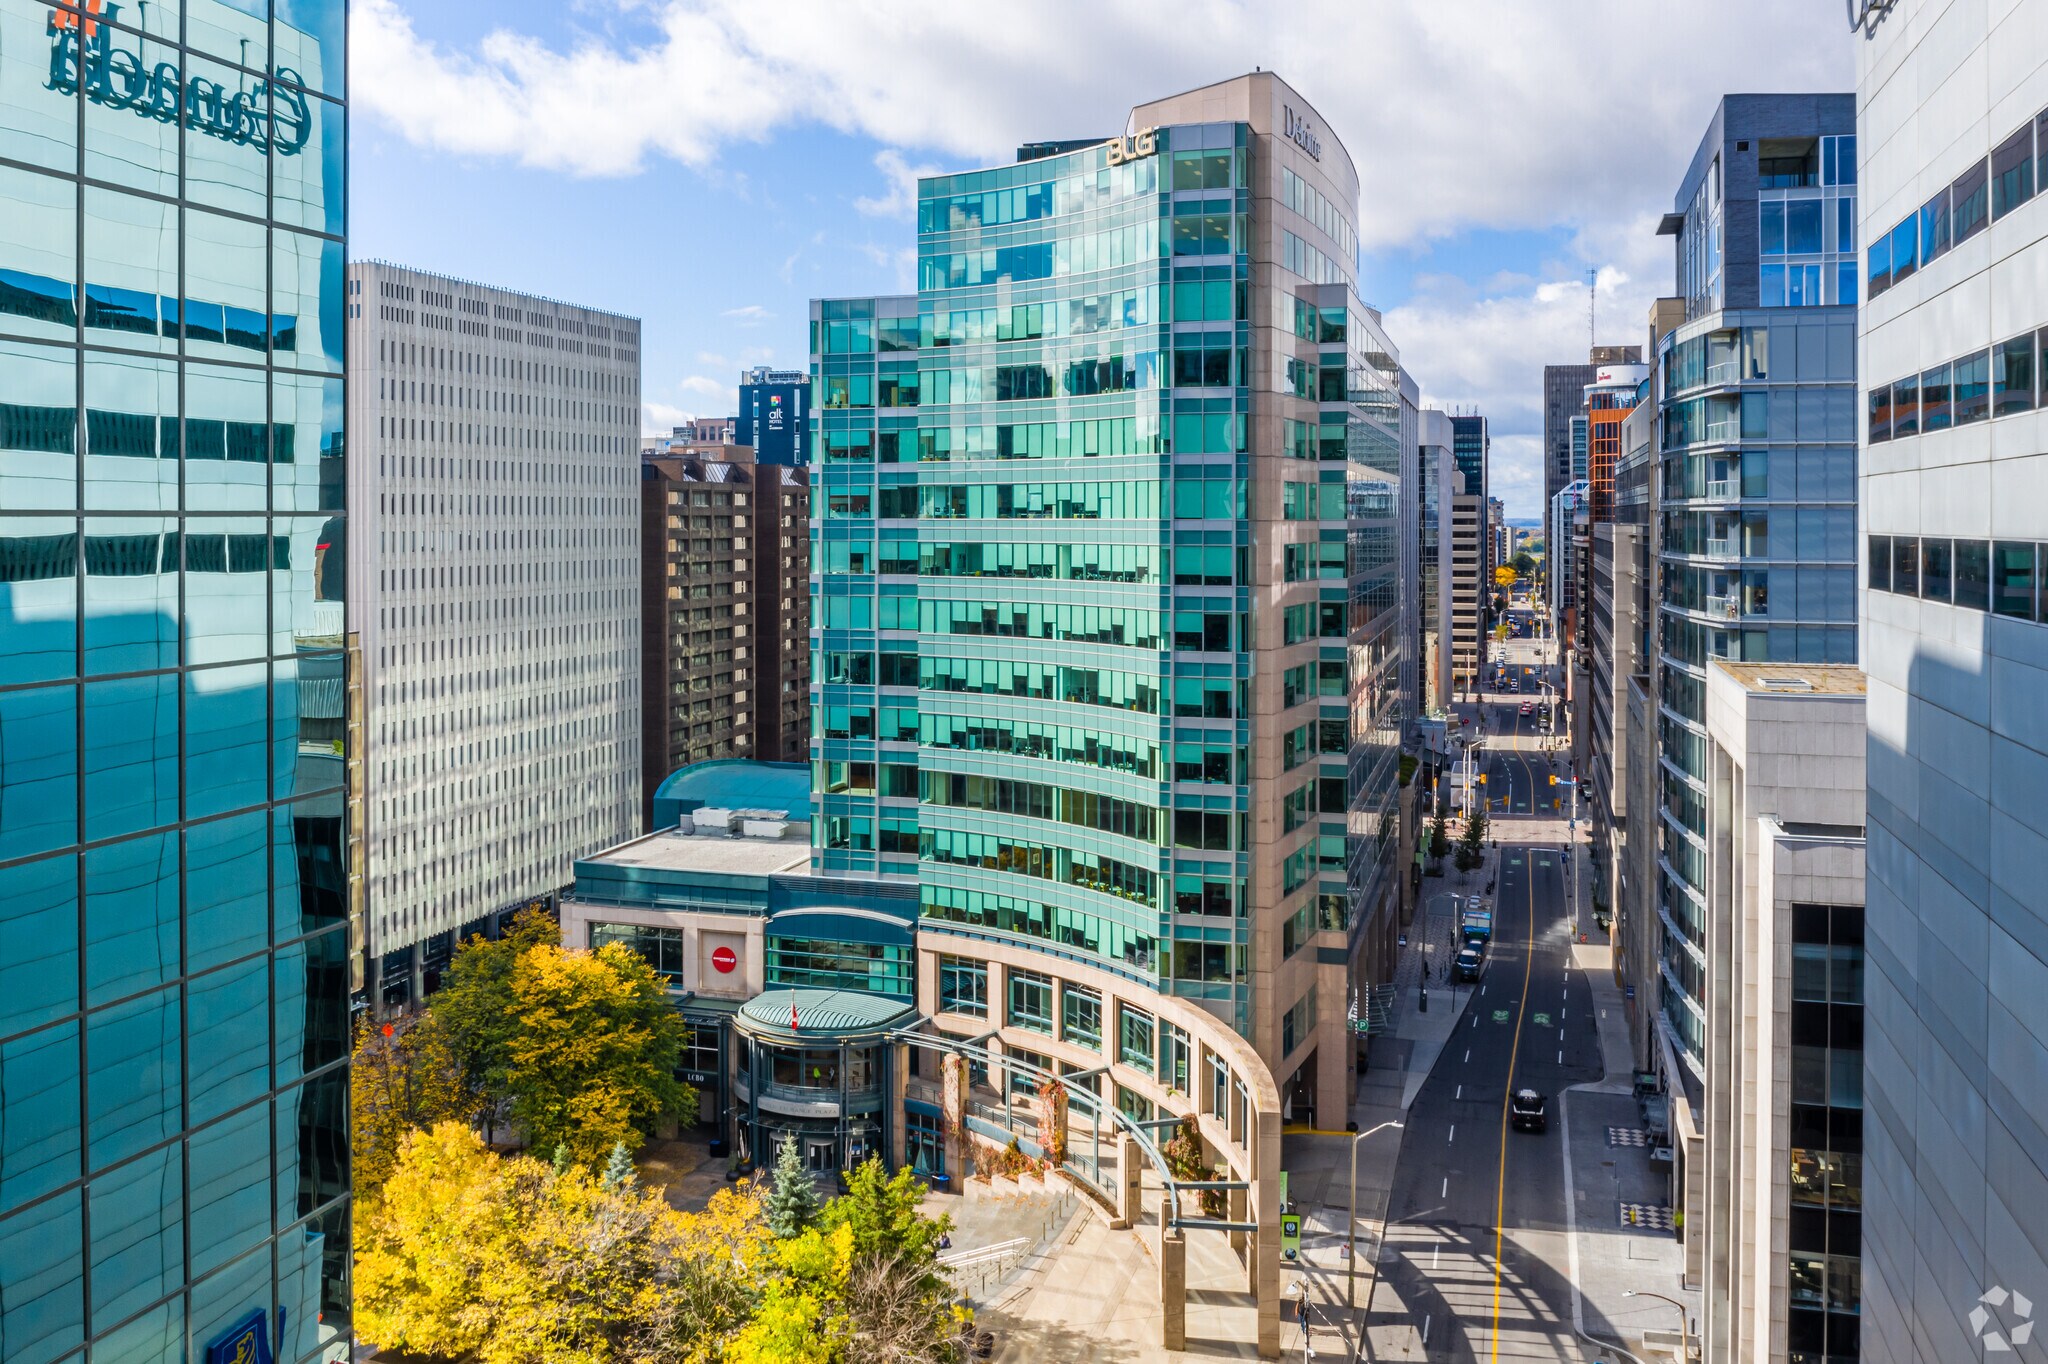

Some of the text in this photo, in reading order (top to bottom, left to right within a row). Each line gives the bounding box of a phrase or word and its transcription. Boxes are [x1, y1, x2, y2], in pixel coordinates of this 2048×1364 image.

[1106, 126, 1154, 166] BLG
[1283, 104, 1321, 163] Deloitte
[769, 408, 783, 420] alt
[687, 1073, 705, 1082] LCBO
